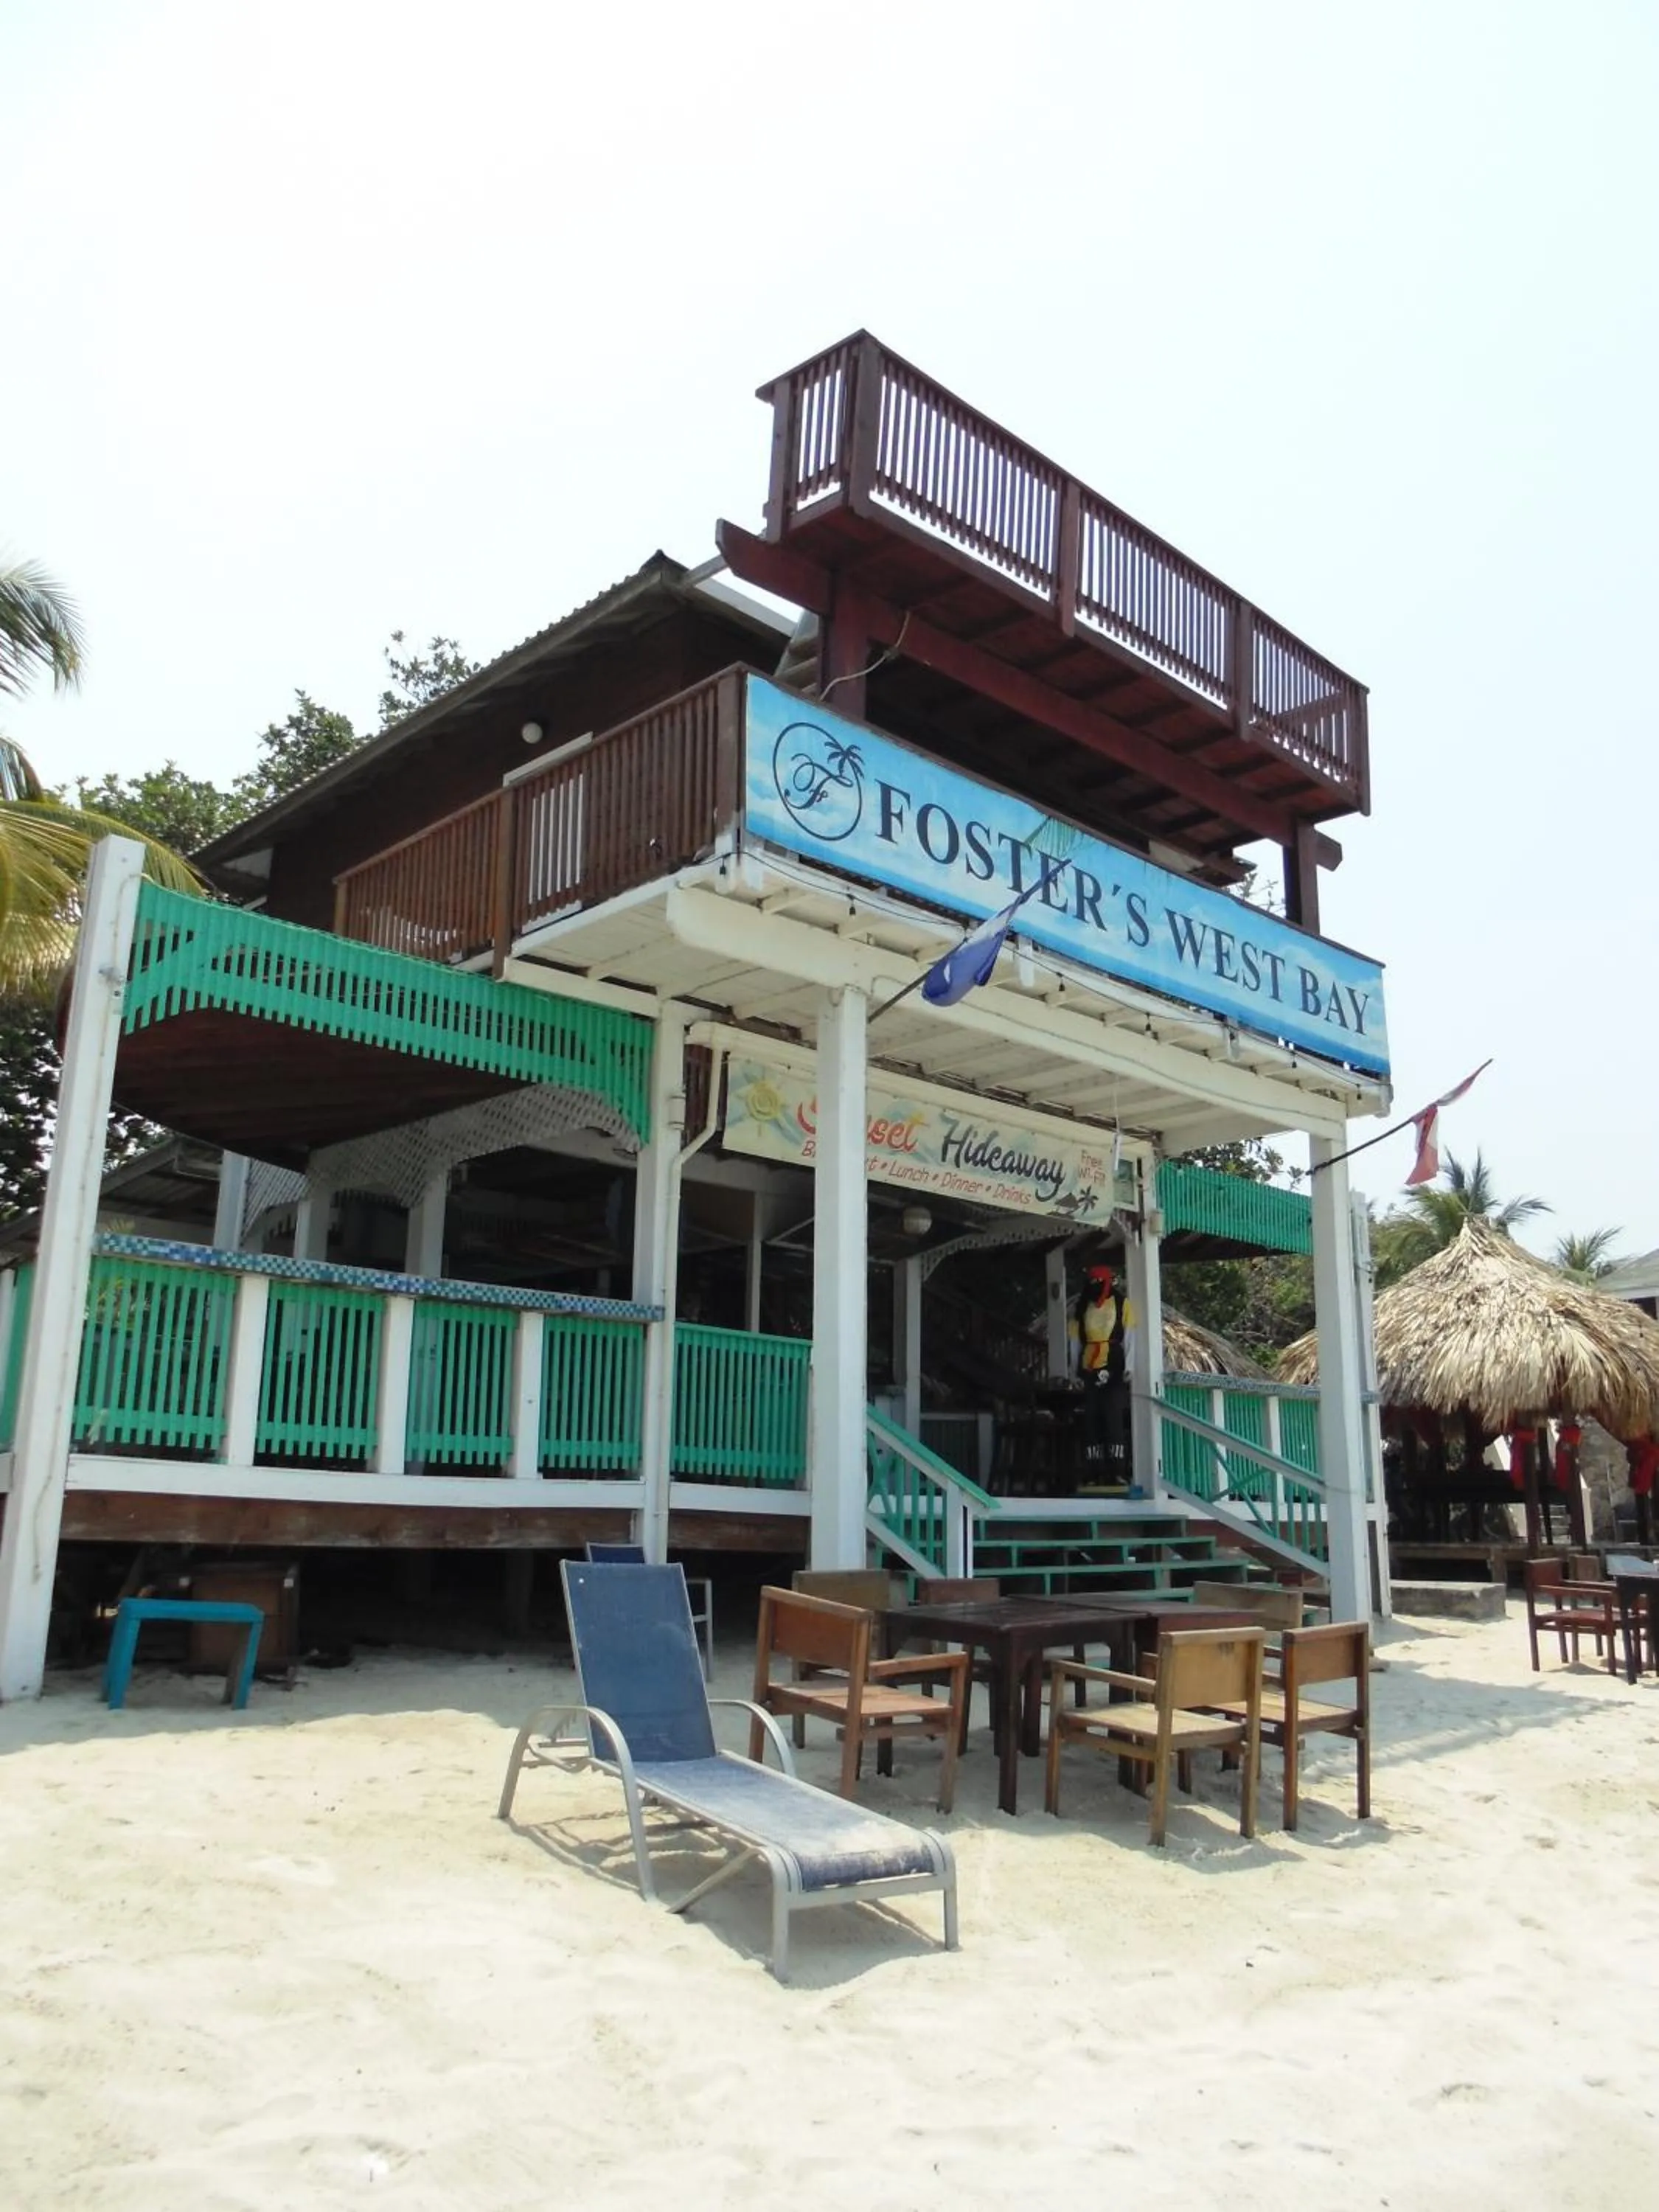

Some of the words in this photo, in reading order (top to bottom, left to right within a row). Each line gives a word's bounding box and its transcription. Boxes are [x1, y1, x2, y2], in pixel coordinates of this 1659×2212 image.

[874, 779, 1150, 947] FOSTER'S
[1164, 908, 1285, 1002] WEST
[1298, 966, 1368, 1035] BAY
[888, 1160, 929, 1183] Lunch
[941, 1172, 984, 1193] Dinner
[992, 1183, 1032, 1204] Drinks
[939, 1115, 1065, 1202] Hideaway
